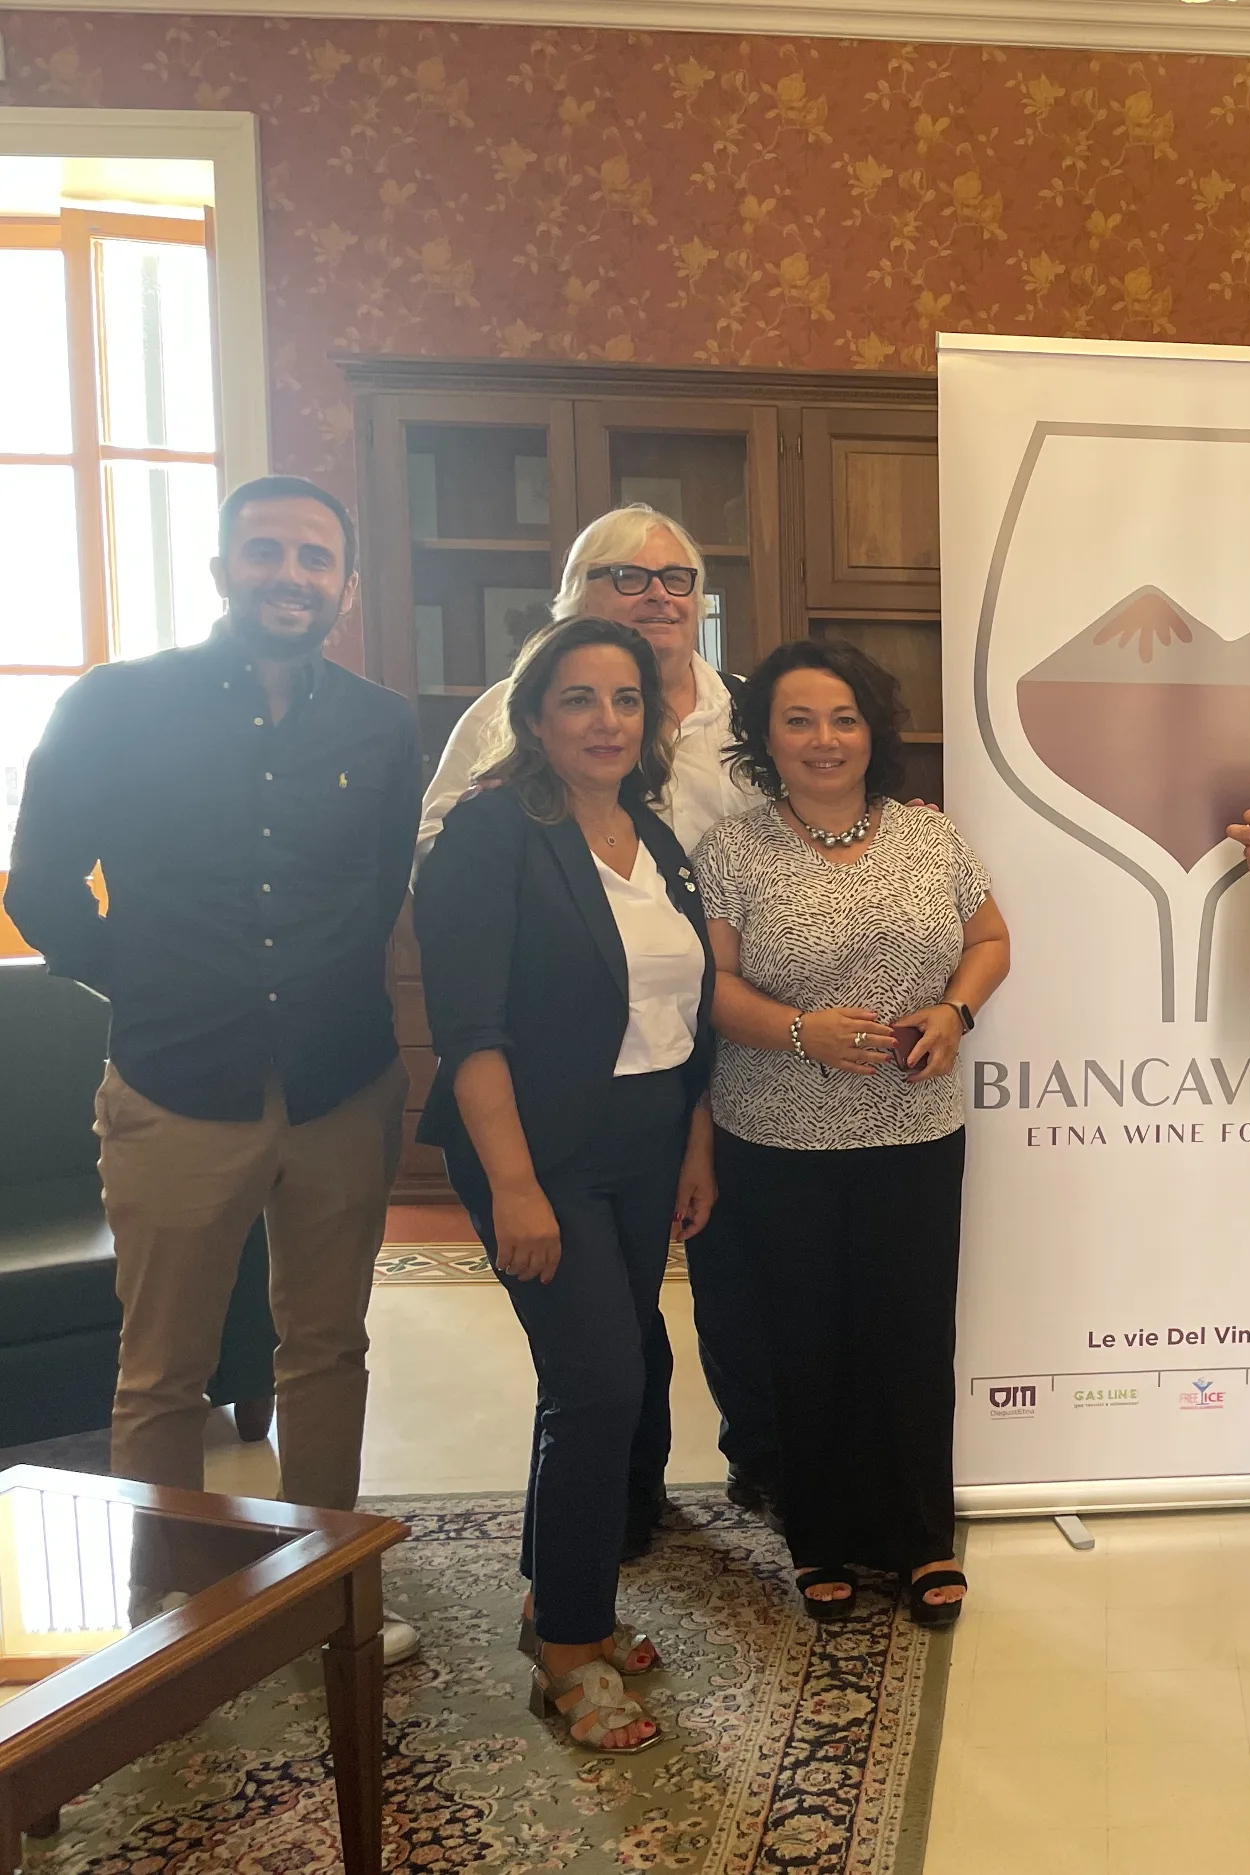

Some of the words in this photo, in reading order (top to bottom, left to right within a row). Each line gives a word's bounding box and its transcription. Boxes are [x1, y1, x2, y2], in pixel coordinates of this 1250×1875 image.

[1027, 1124, 1107, 1147] ETNA
[1123, 1123, 1205, 1145] WINE
[1088, 1331, 1116, 1348] Le
[1124, 1328, 1159, 1347] vie
[1167, 1326, 1206, 1345] Del
[1074, 1389, 1104, 1401] GAS
[1107, 1388, 1137, 1400] LINE
[1179, 1392, 1199, 1404] FREE
[1204, 1392, 1224, 1403] ICE
